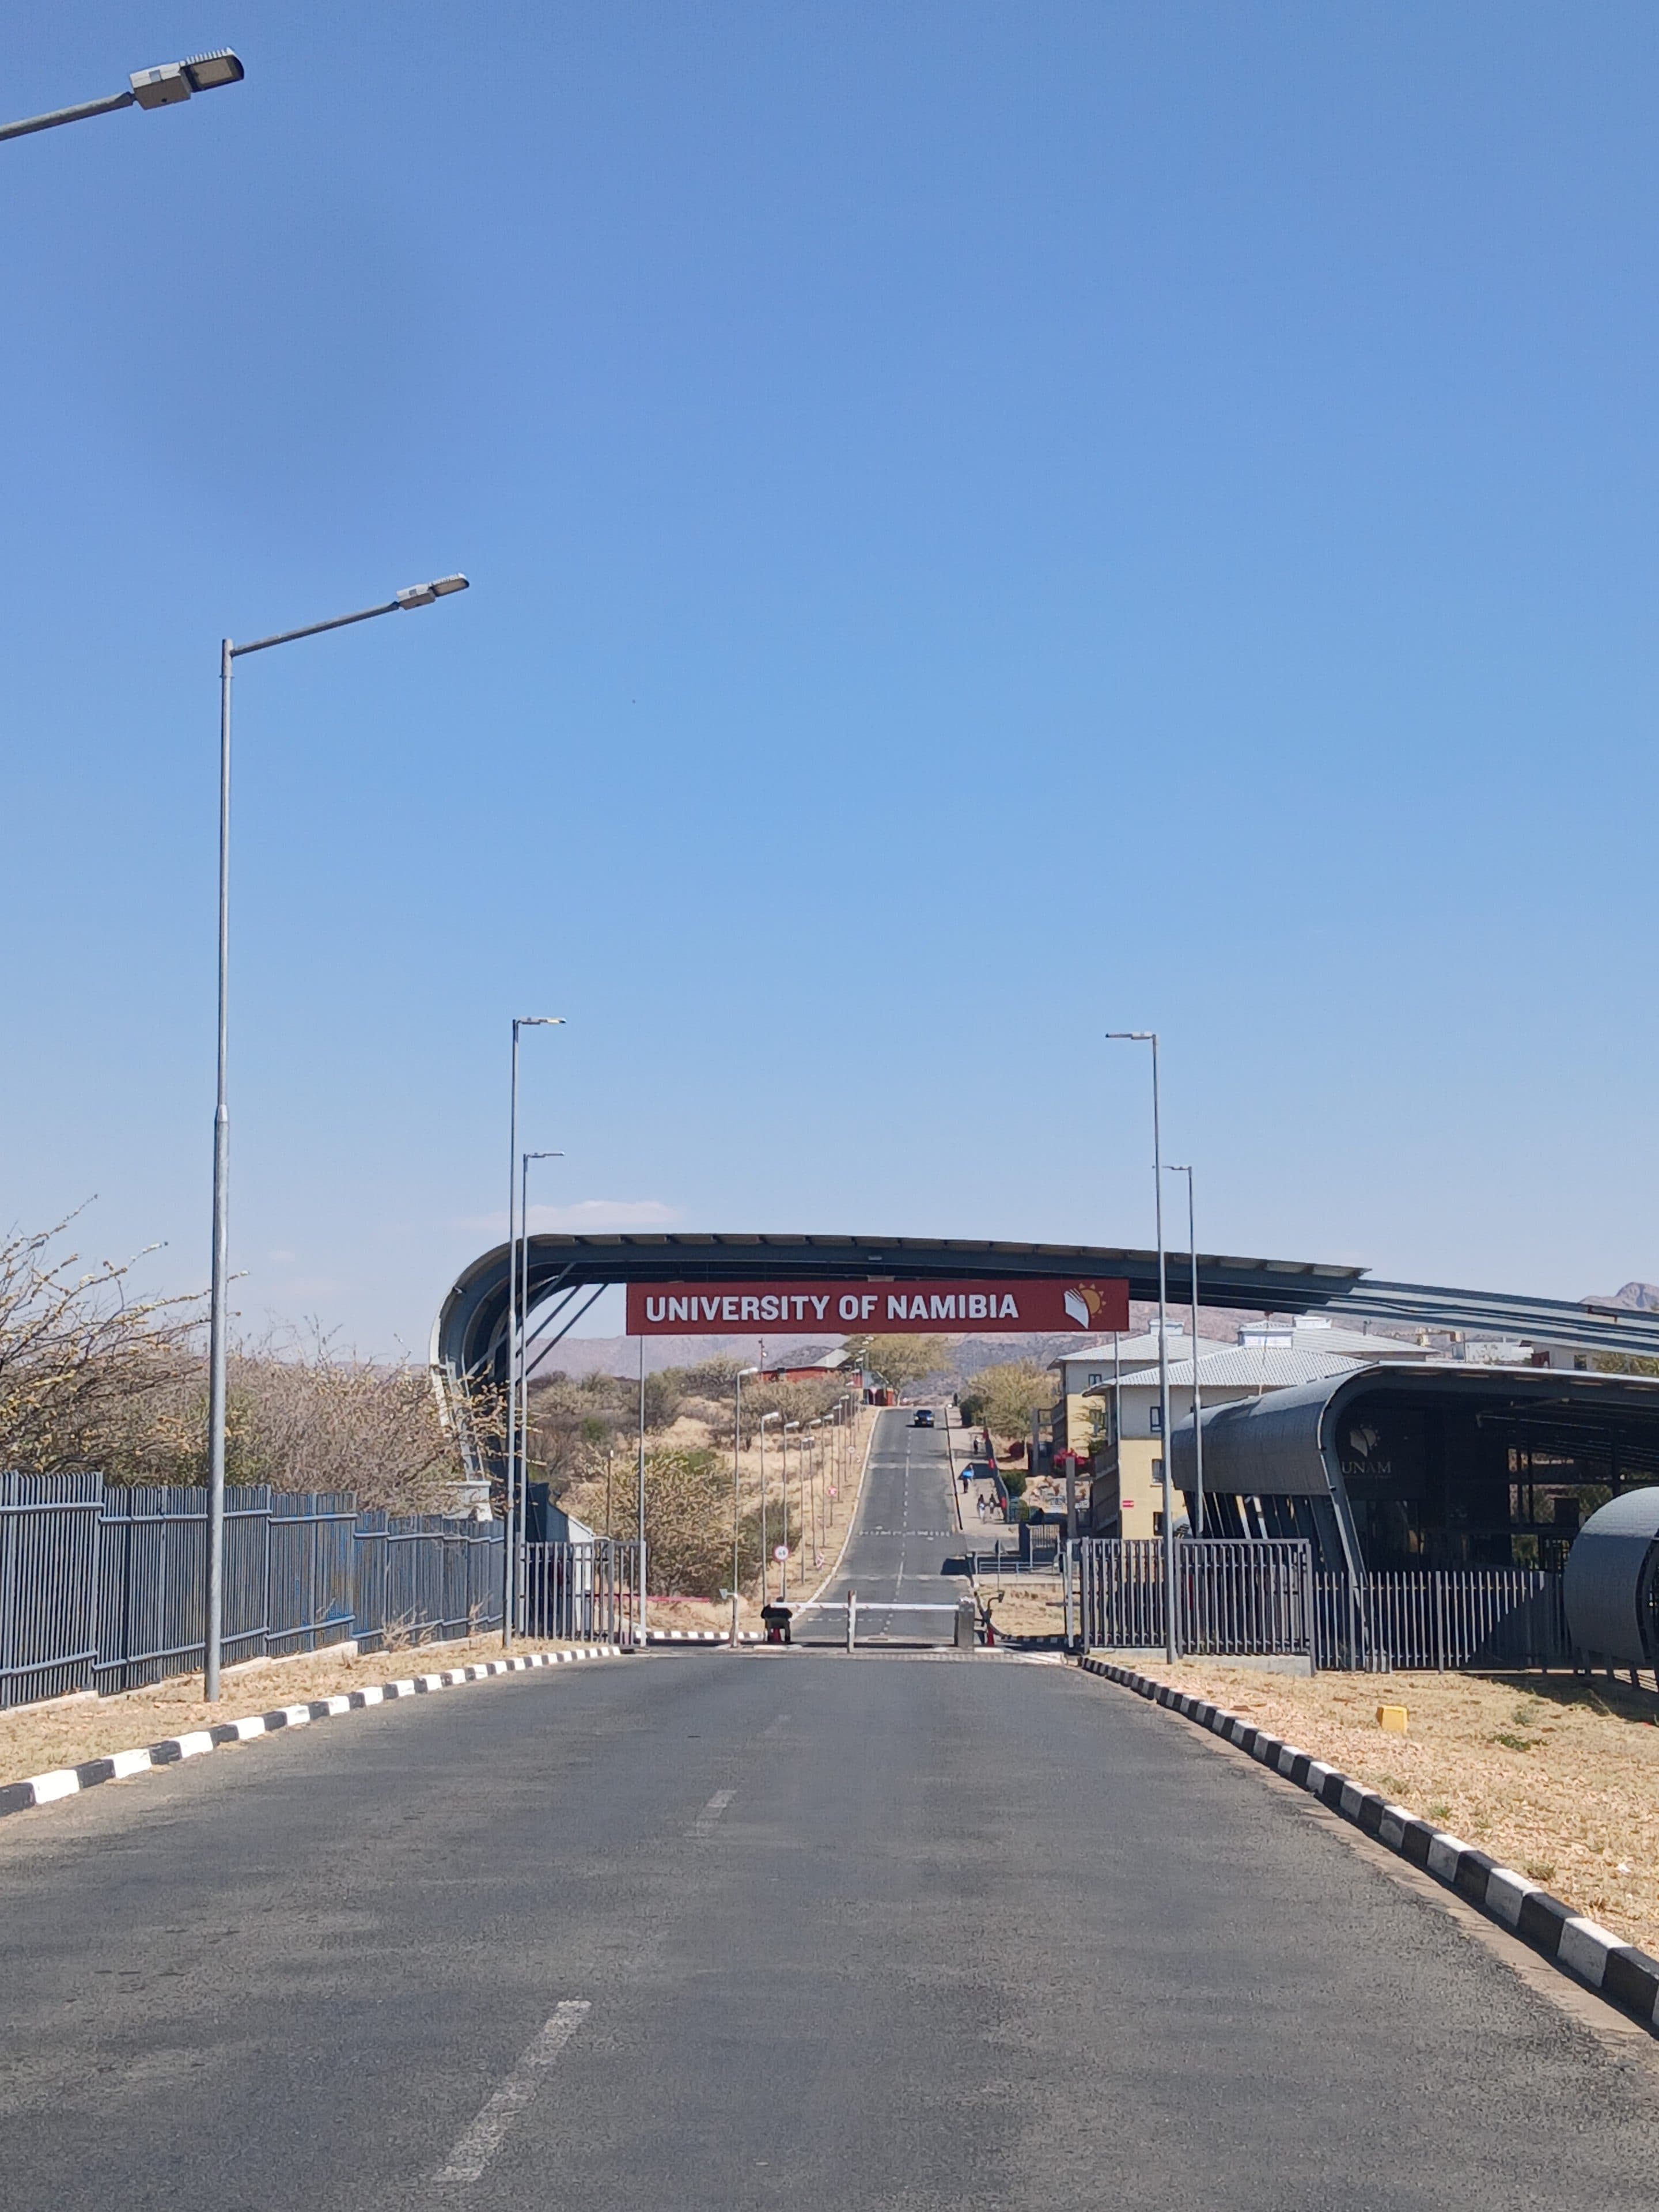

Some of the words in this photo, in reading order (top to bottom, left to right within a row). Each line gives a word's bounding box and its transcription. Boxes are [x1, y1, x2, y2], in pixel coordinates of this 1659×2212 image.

[646, 1295, 830, 1321] UNIVERSITY
[839, 1294, 878, 1320] OF
[887, 1294, 1019, 1319] NAMIBIA
[1342, 1460, 1391, 1474] UNAM
